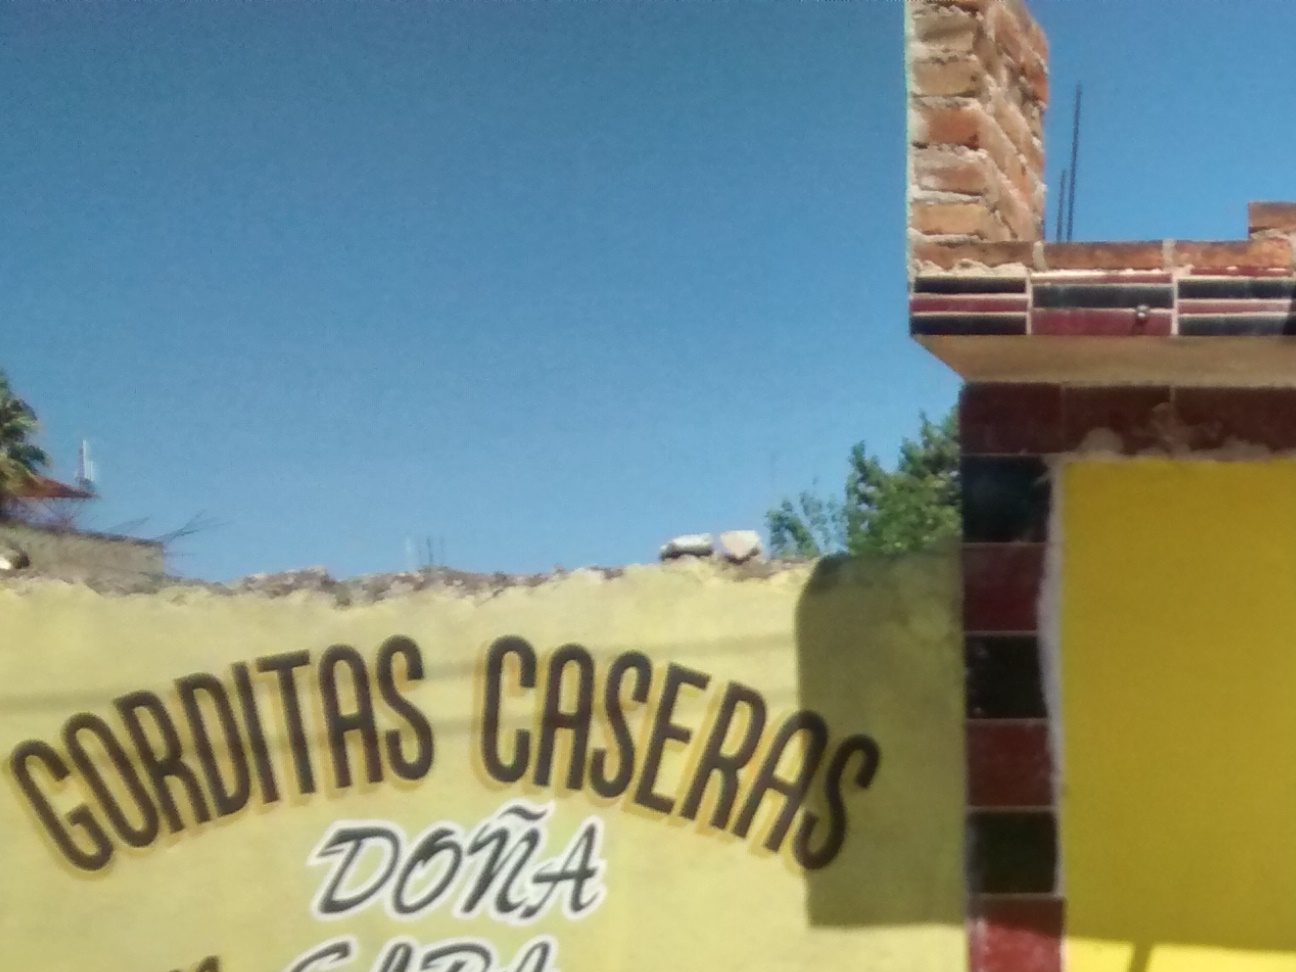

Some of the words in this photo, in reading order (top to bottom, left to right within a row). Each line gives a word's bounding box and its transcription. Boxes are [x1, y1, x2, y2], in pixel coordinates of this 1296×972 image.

[7, 633, 436, 877] GORDITAS
[481, 633, 883, 873] CASERAS
[309, 802, 605, 918] DOÑA
